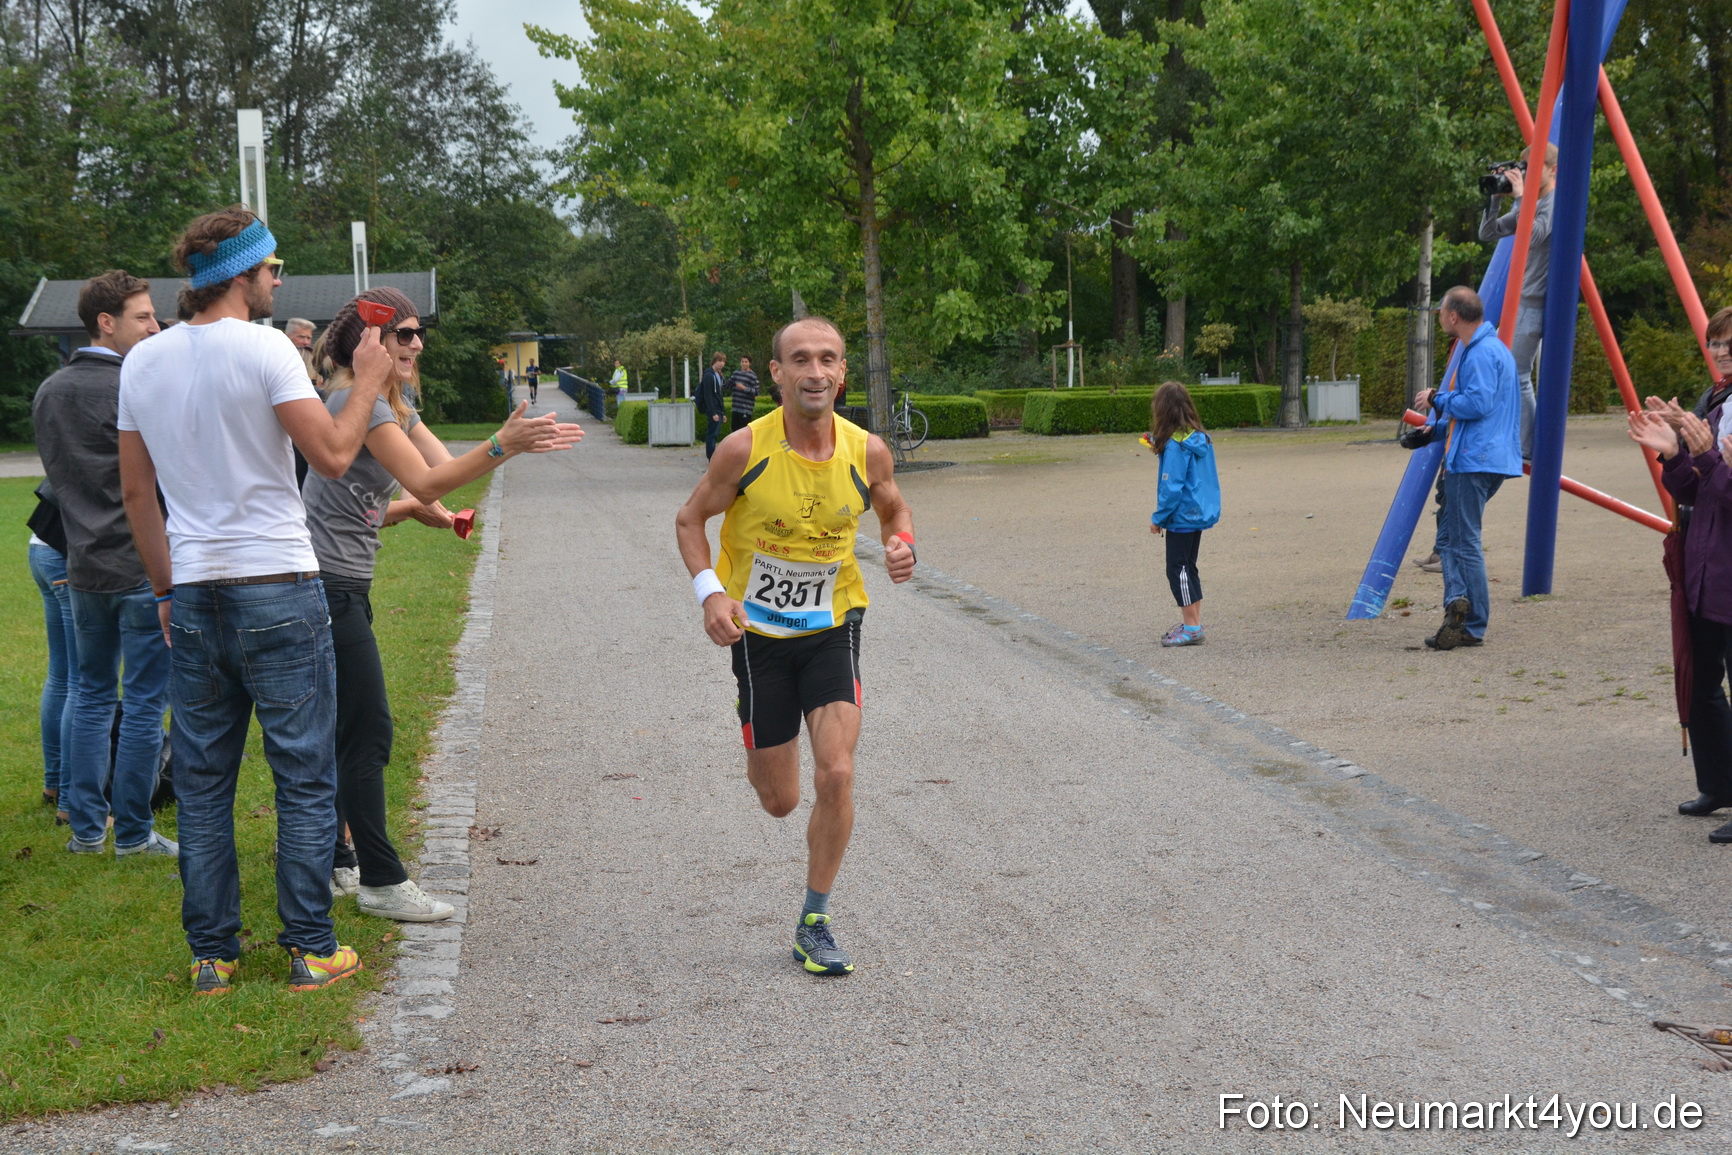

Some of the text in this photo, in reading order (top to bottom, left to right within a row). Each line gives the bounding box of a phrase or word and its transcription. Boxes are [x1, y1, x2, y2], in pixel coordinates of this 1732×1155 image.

[756, 538, 767, 549] M
[769, 544, 779, 553] &
[782, 546, 791, 555] S
[755, 558, 825, 578] PARTL Neumarkt
[755, 573, 826, 609] 2351
